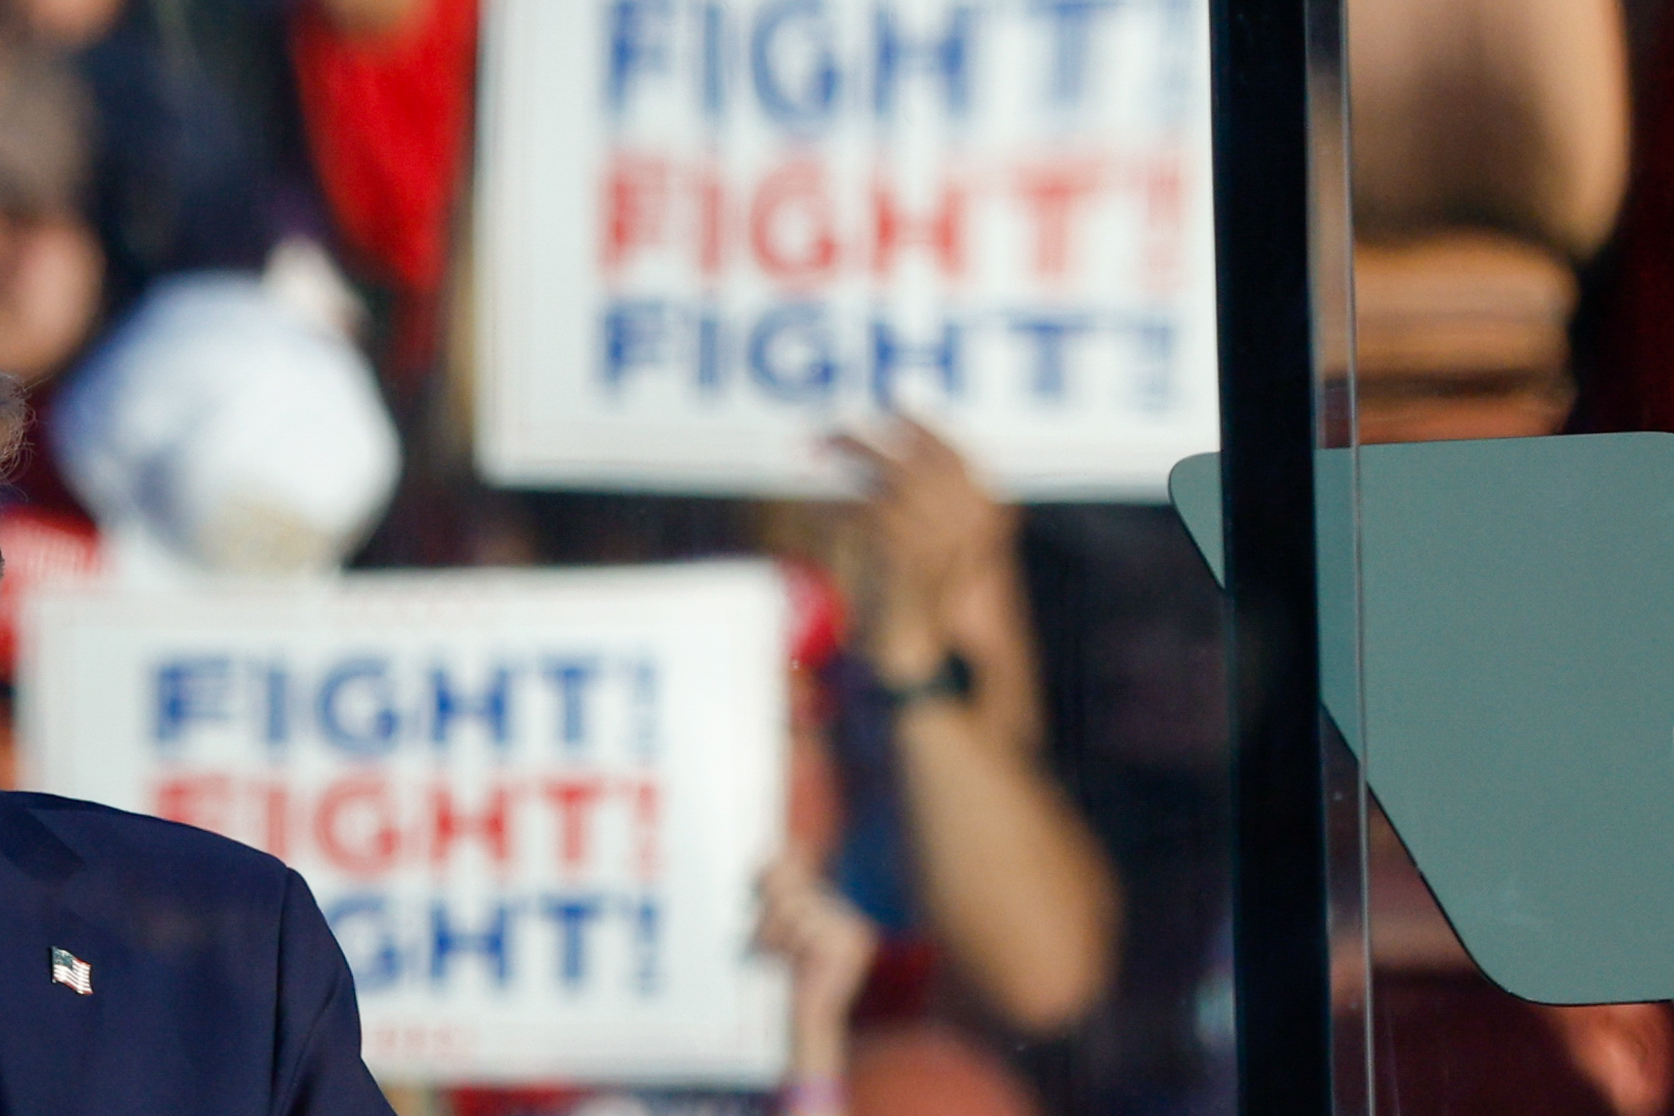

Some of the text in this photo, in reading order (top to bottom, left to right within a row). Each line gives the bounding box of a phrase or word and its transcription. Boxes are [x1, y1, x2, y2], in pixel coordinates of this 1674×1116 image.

[596, 148, 1194, 290] FIGHT!
[594, 300, 1178, 408] FIGHT!
[148, 653, 664, 754] FIGHT!
[326, 895, 662, 992] GHT!
